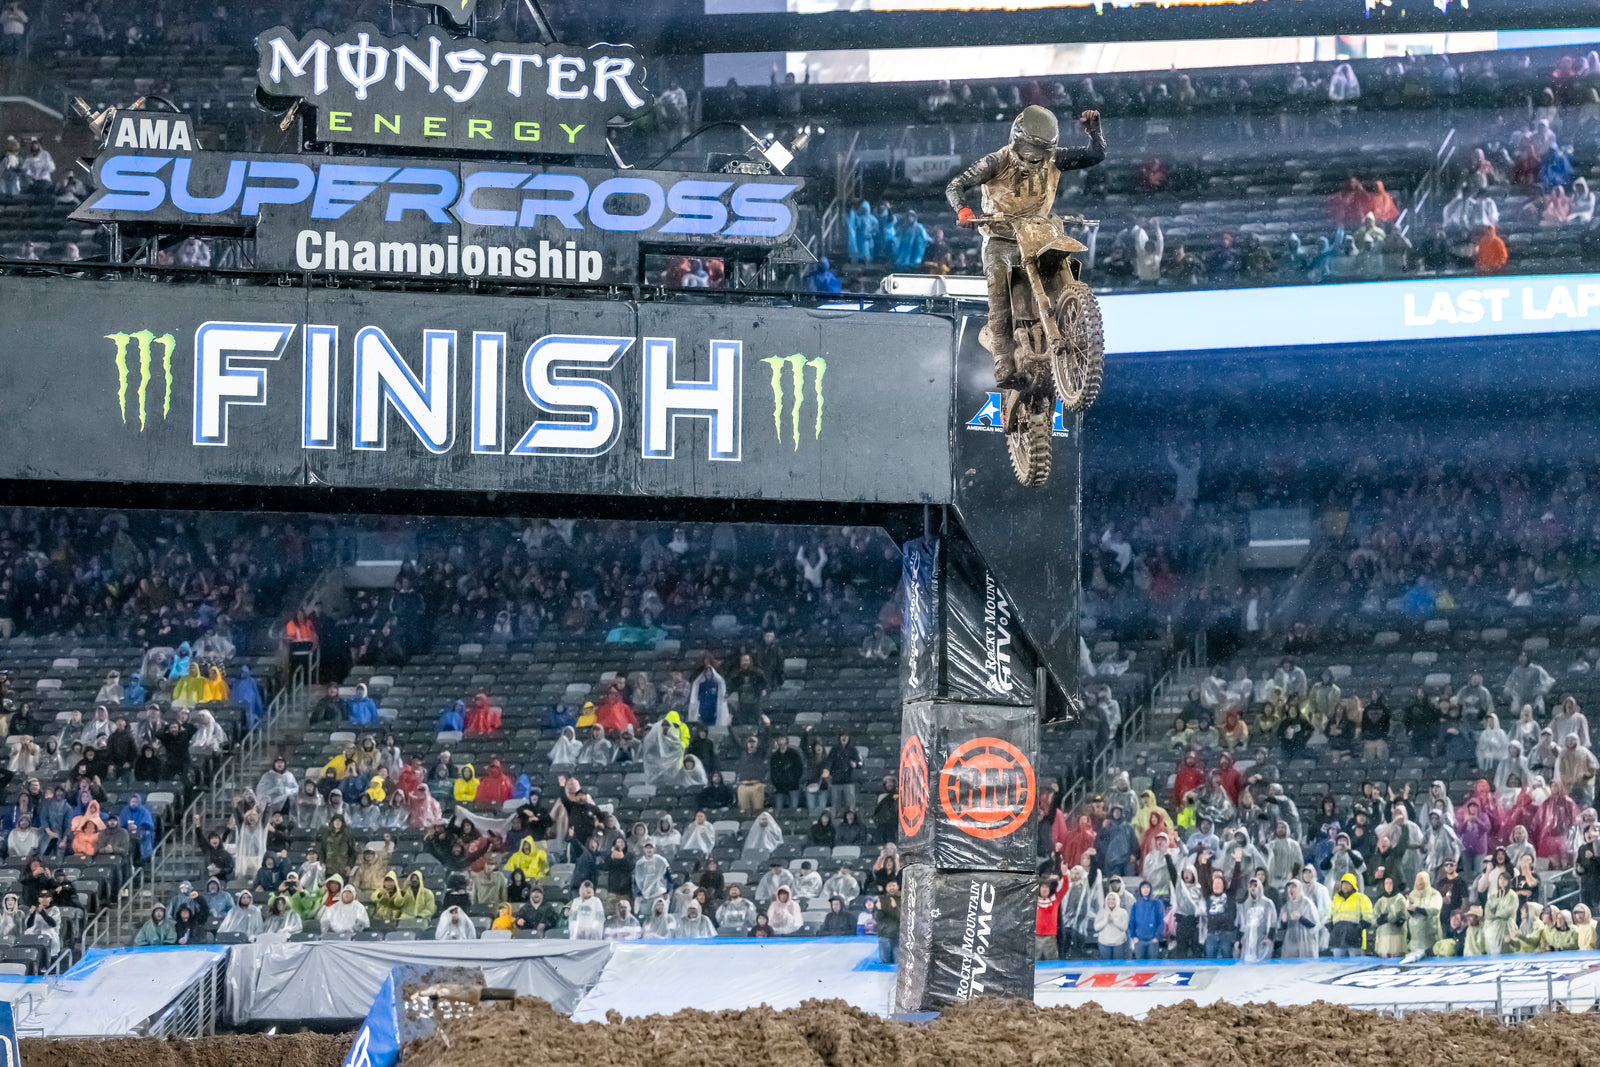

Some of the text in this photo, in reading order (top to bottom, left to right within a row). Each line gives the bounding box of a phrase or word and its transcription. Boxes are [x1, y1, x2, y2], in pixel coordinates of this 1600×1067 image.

[269, 33, 645, 109] MONSTER
[115, 118, 192, 151] AMA
[329, 111, 586, 143] ENERGY
[89, 155, 799, 237] SUPERCROSS
[296, 229, 603, 282] Championship
[1404, 284, 1600, 326] LAST LAP
[192, 321, 743, 462] FINISH
[984, 626, 996, 672] ROCKY
[957, 880, 980, 1000] ROCKY MOUNTAIN
